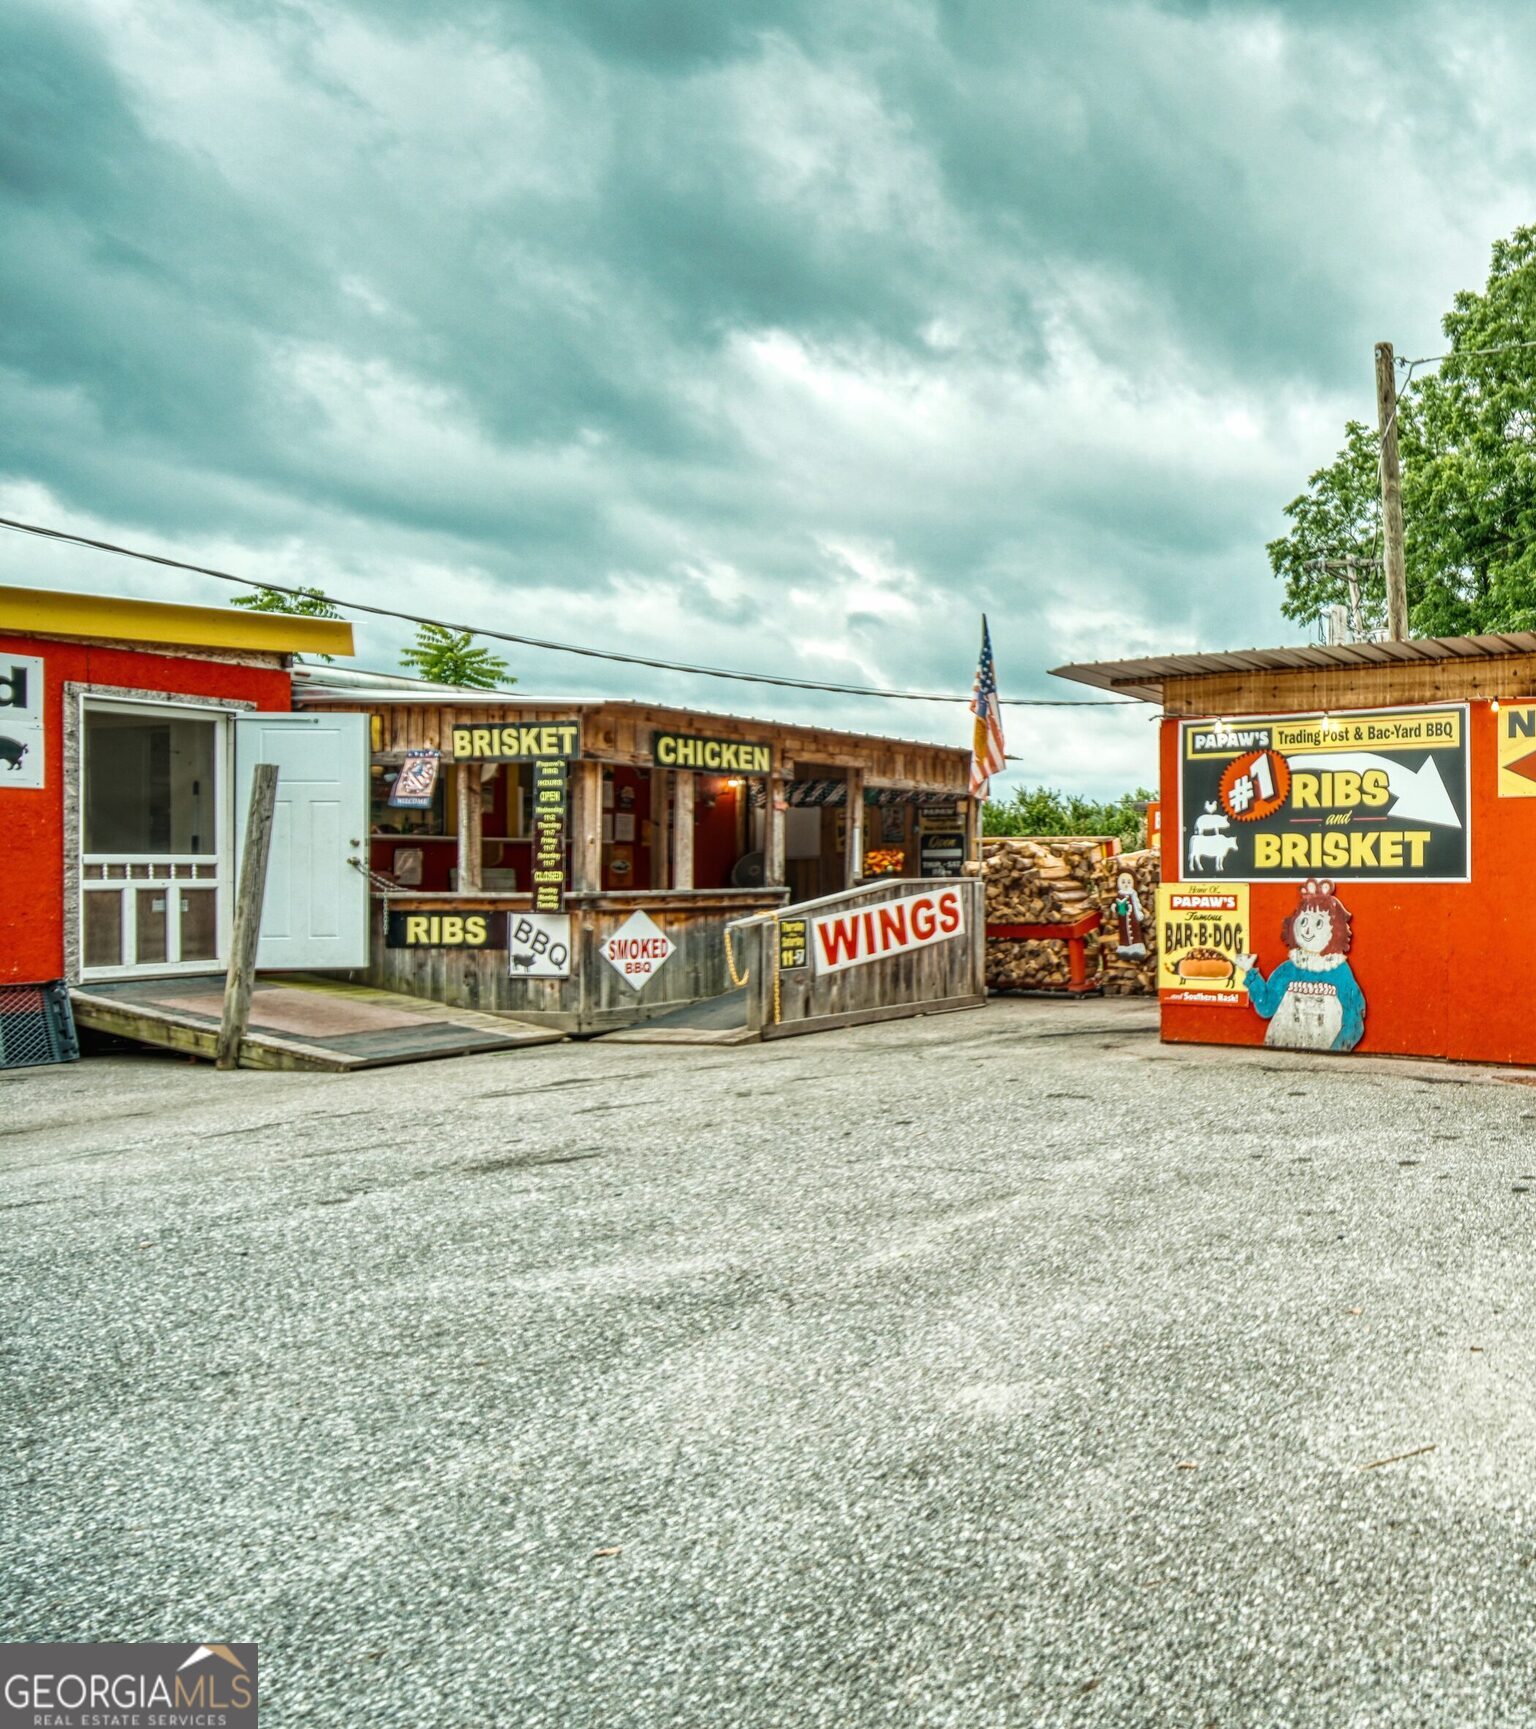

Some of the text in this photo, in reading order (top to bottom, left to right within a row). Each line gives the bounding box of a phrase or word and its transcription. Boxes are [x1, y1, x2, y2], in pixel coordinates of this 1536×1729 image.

[453, 727, 577, 758] BRISKET
[1194, 730, 1270, 750] PAPAW'S
[1278, 720, 1453, 746] Trading Post & Bac-Yard BBQ
[657, 736, 770, 773] CHICKEN
[1228, 752, 1275, 815] #1
[1291, 768, 1390, 809] RIBS
[1325, 810, 1351, 826] and
[1254, 831, 1431, 869] BRISKET
[1172, 896, 1236, 908] PAPAW'S
[1185, 911, 1222, 921] Famous
[406, 915, 488, 946] RIBS
[819, 890, 961, 966] WINGS
[514, 918, 567, 970] BBQ
[609, 938, 668, 960] SMOKED
[625, 962, 652, 974] BBQ
